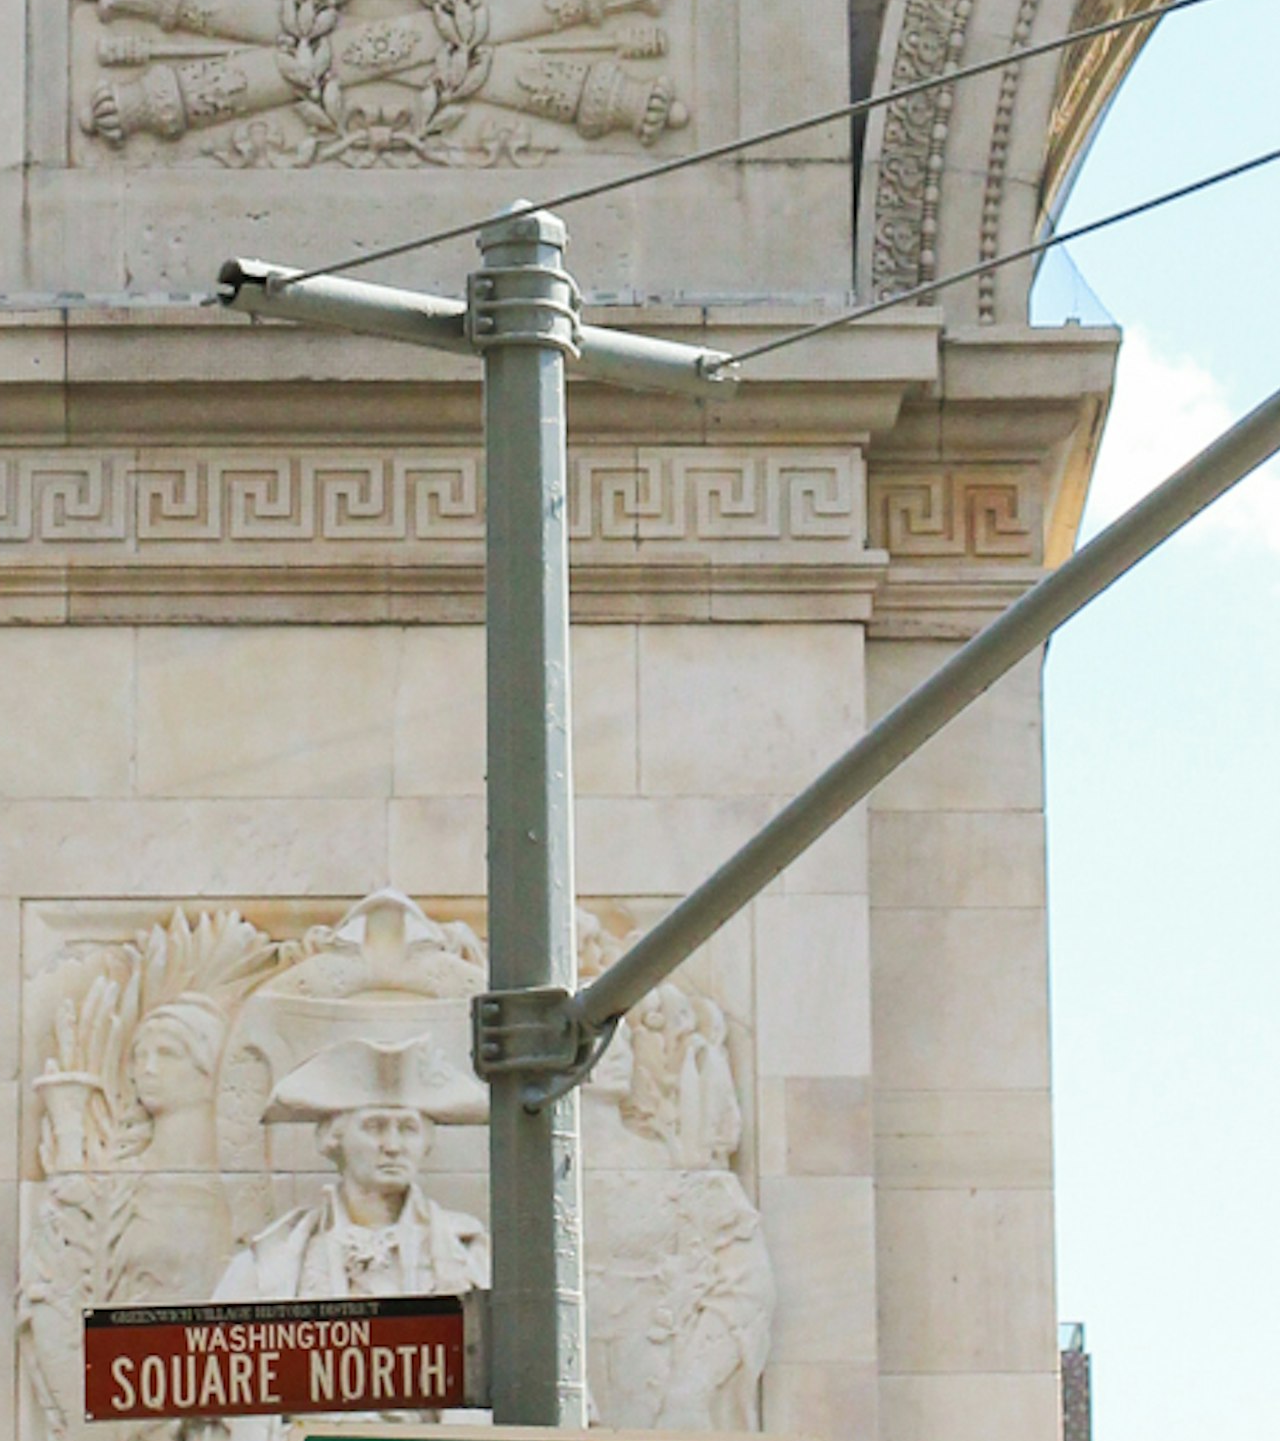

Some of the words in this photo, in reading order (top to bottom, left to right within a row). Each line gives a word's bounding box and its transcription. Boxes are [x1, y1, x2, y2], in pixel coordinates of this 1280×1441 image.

[185, 1321, 371, 1354] WASHINGTON
[111, 1351, 282, 1411] SQUARE
[309, 1344, 447, 1403] NORTH
